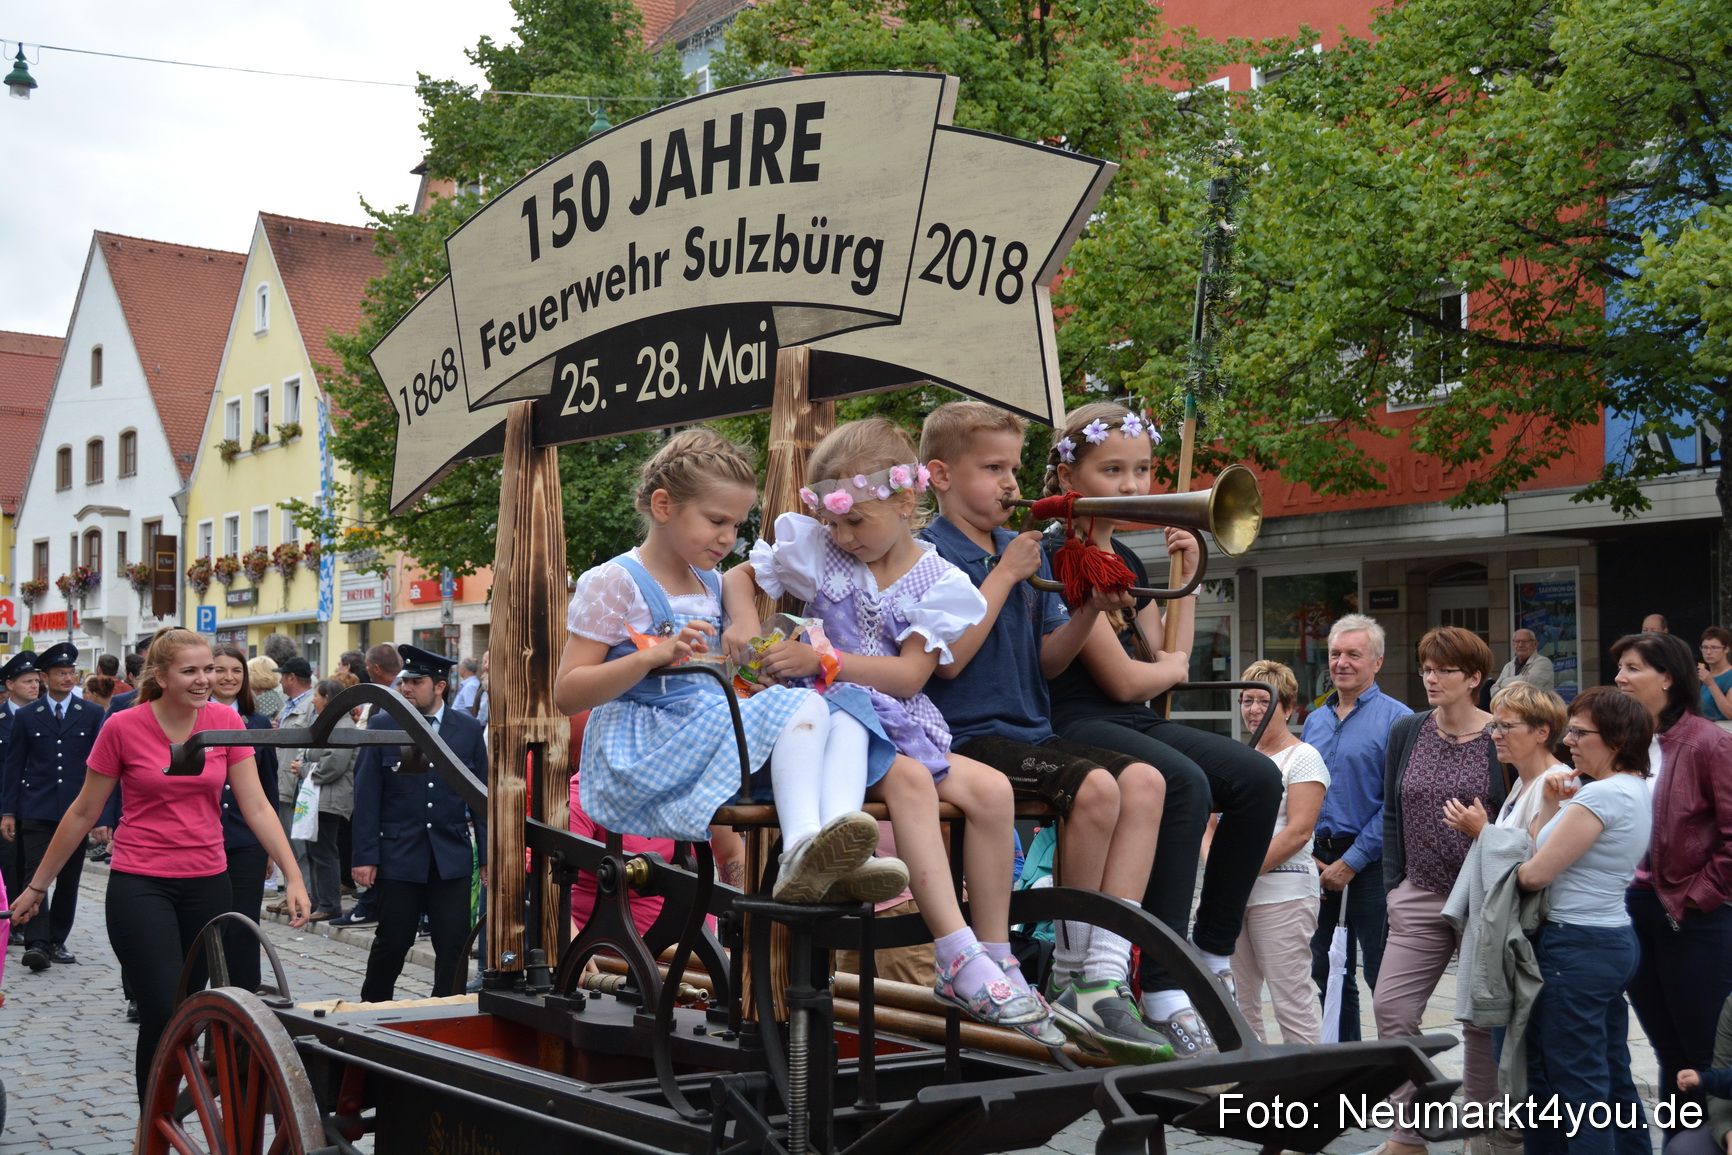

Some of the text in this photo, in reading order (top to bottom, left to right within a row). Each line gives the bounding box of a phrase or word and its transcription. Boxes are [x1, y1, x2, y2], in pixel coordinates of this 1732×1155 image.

[521, 101, 826, 263] 150 JAHRE
[479, 213, 884, 370] Feuerwehr Sulzbürg
[919, 222, 1028, 305] 2018
[400, 347, 459, 426] 1868
[560, 358, 607, 417] 25.
[636, 341, 688, 403] 28.
[698, 320, 767, 391] Mai
